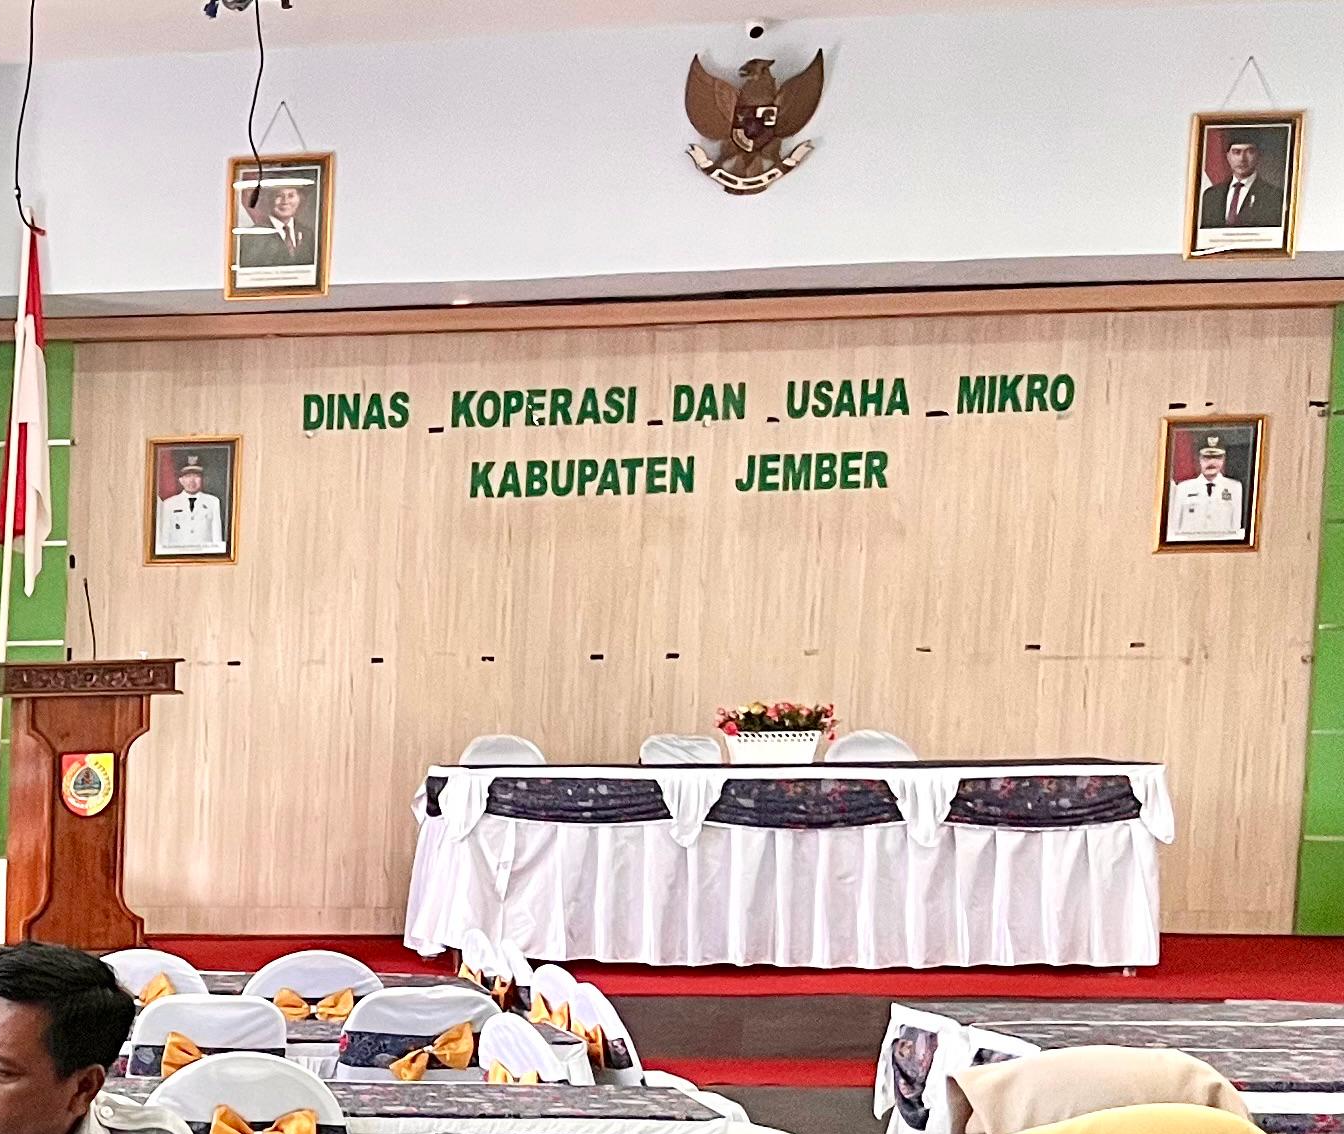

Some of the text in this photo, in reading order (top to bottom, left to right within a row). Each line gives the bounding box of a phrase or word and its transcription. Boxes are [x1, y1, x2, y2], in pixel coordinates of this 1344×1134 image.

[303, 374, 1075, 430] DINAS KOPERASI DAN USAHA MIKRO
[470, 451, 888, 497] KABUPATEN JEMBER
